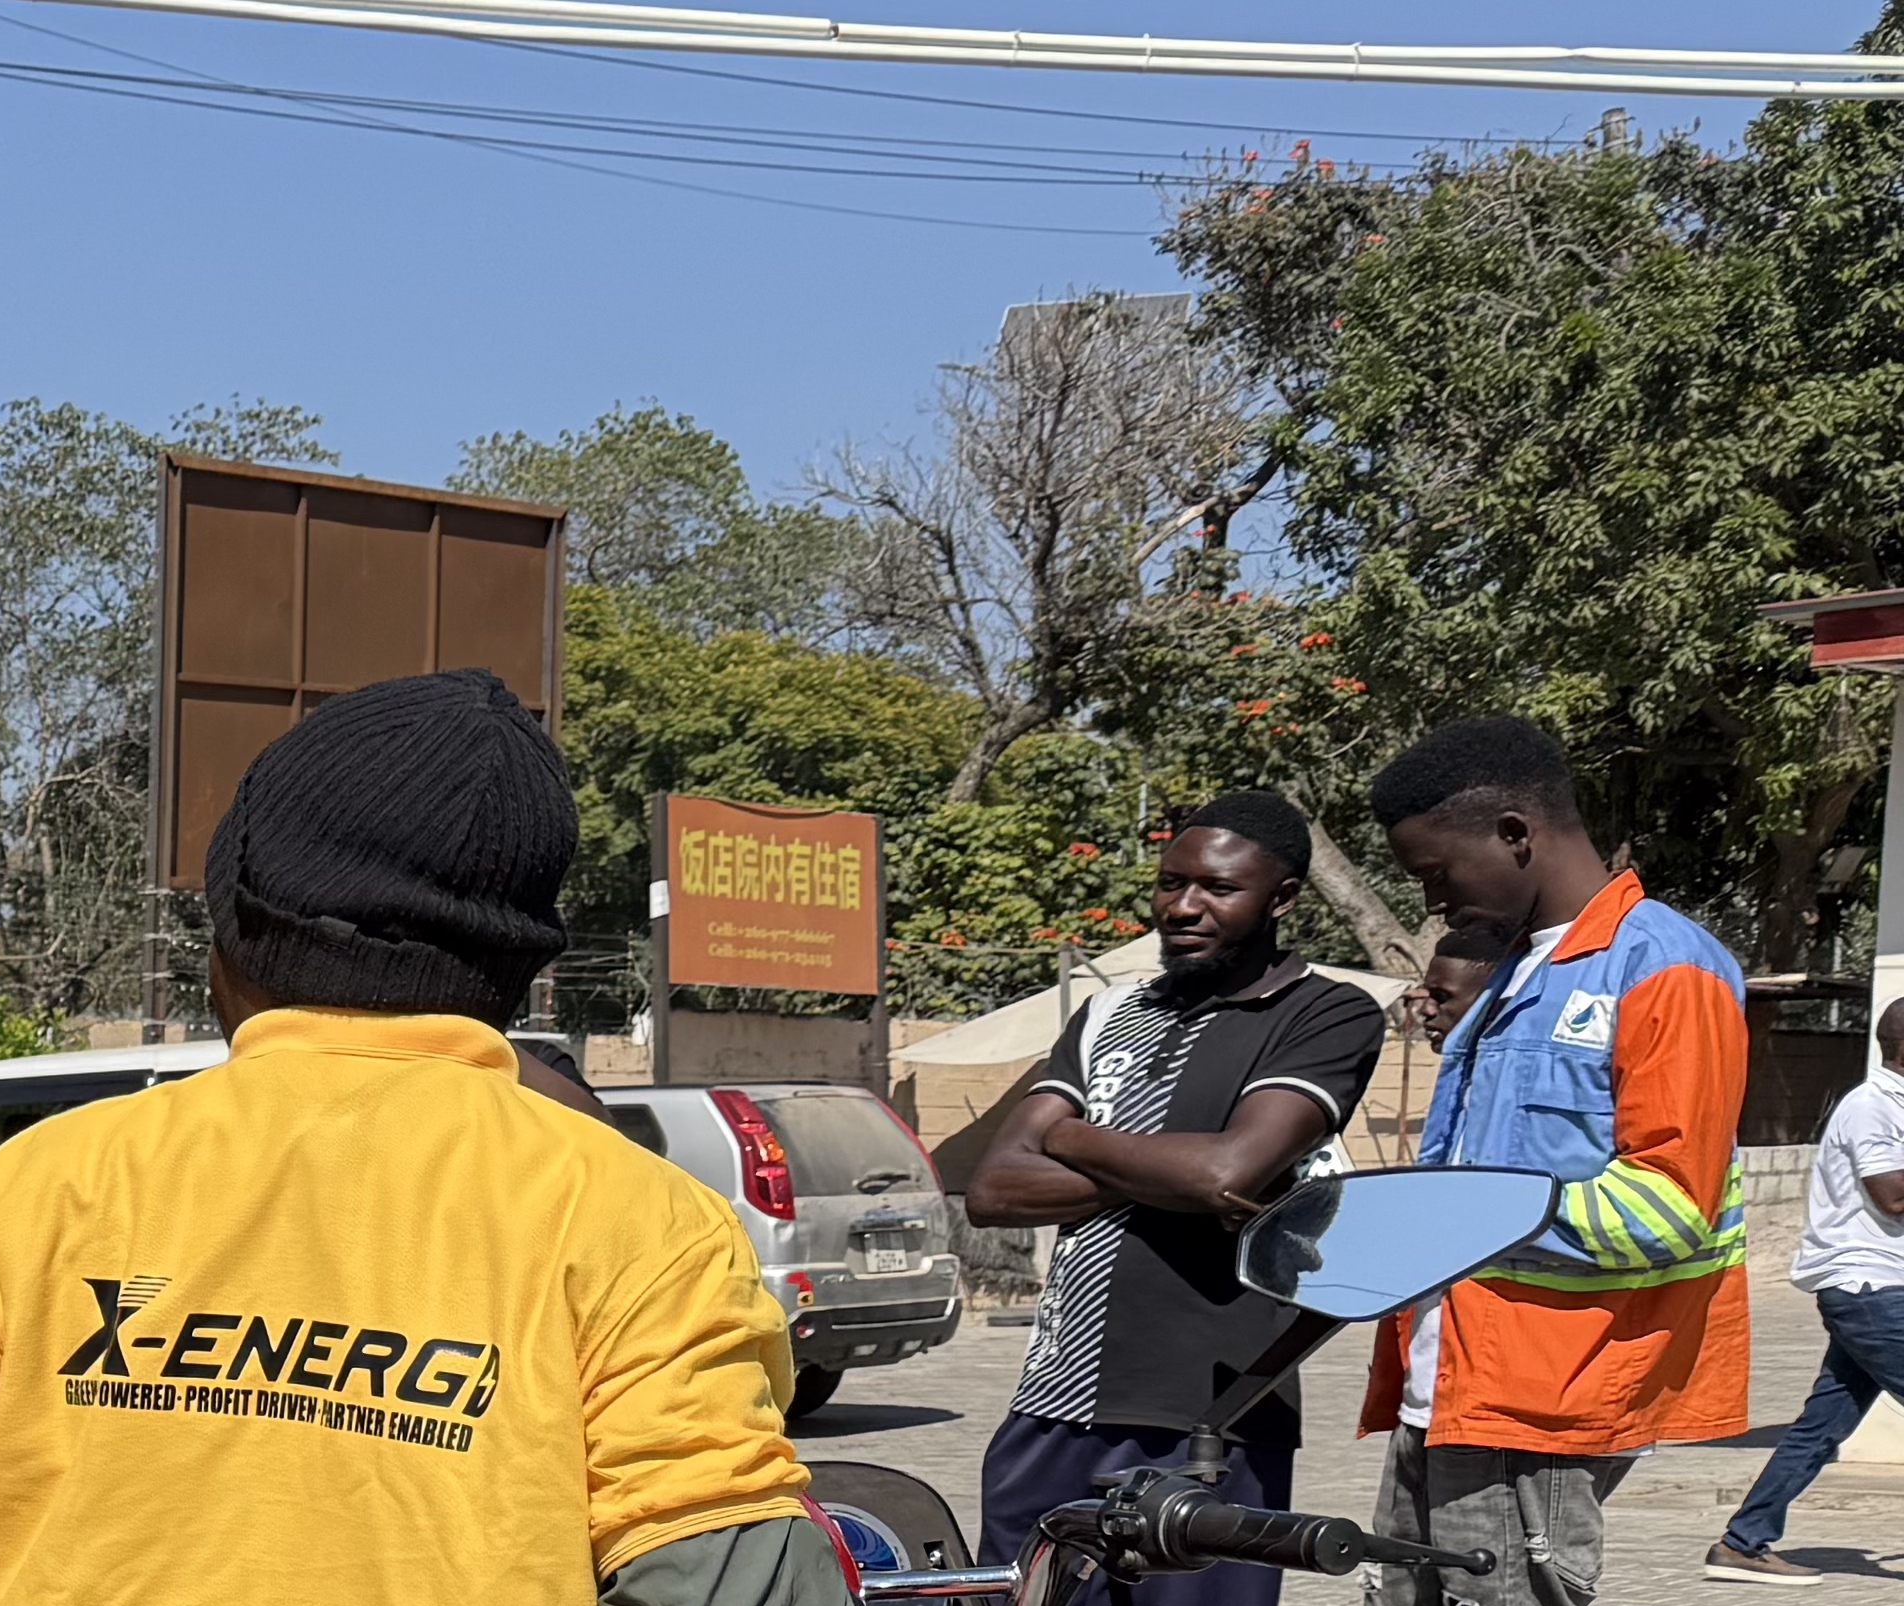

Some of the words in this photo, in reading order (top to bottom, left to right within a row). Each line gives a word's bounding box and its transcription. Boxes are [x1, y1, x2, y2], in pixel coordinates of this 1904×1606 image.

[679, 827, 861, 911] 饭店院内有住宿
[1087, 1051, 1134, 1127] GRE
[388, 1412, 474, 1453] ENABLED
